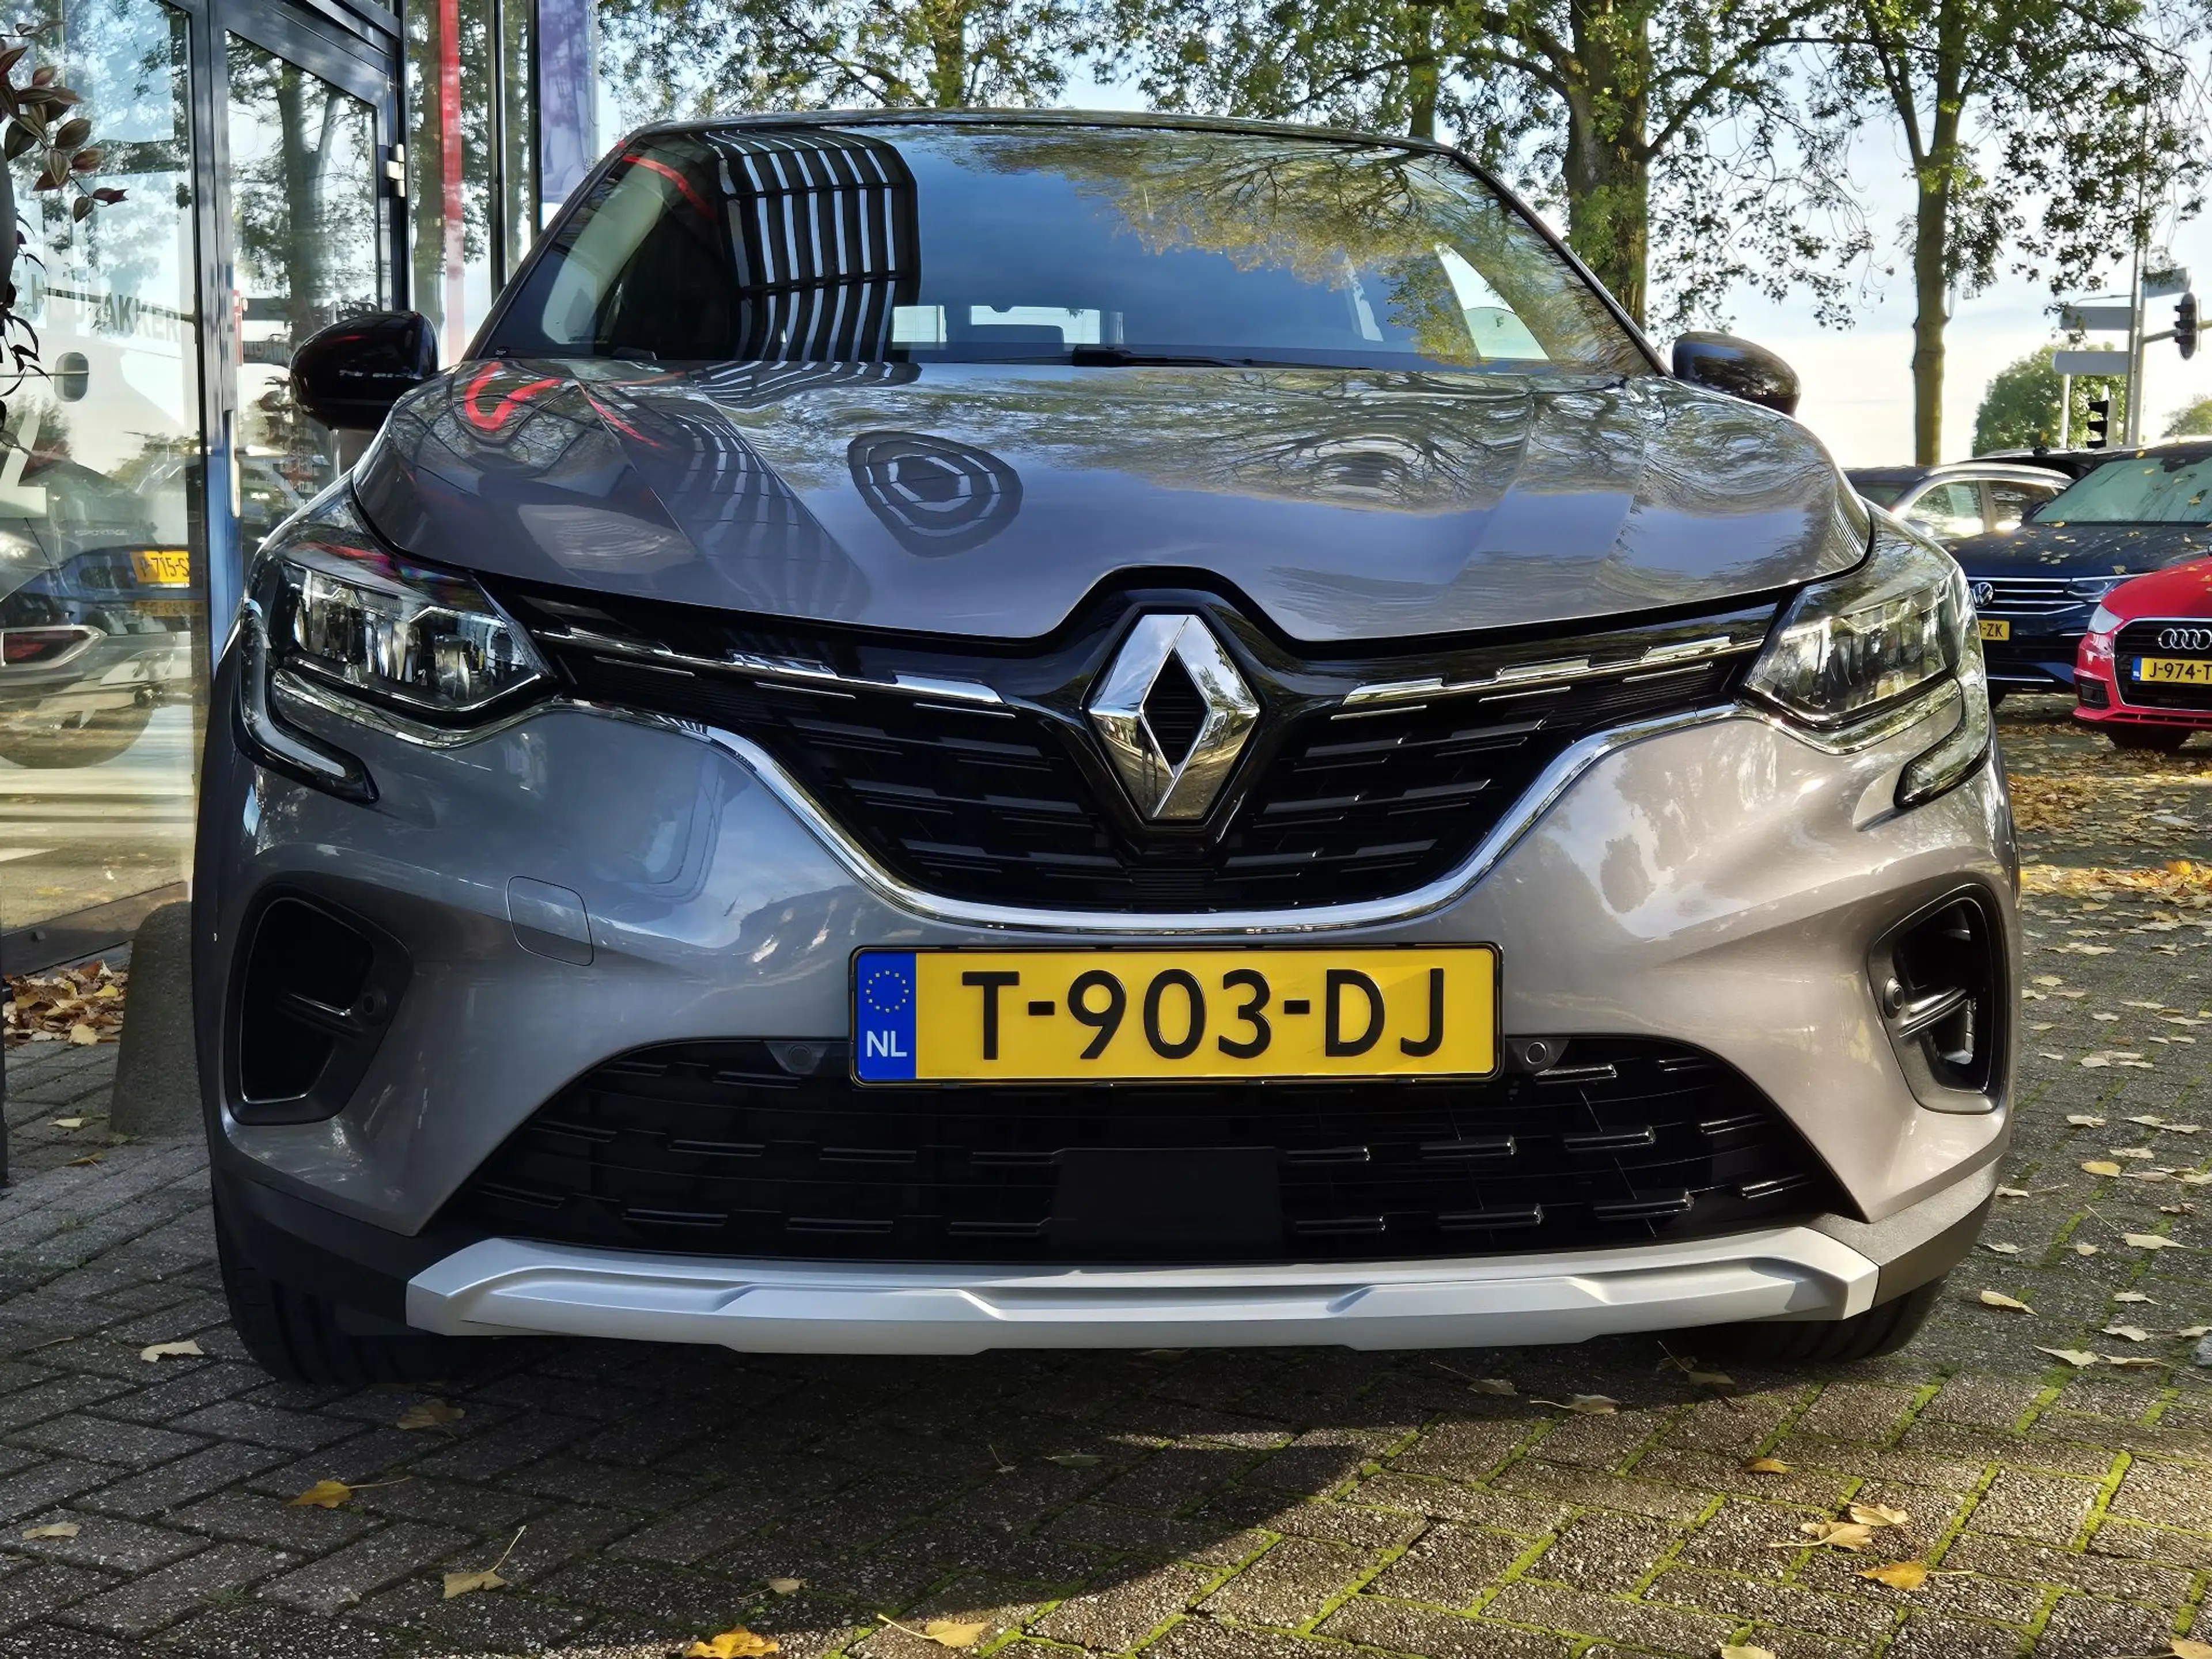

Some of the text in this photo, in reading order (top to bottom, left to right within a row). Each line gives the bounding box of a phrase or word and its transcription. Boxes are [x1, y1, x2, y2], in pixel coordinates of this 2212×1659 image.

[138, 557, 190, 577] P-715-S
[962, 968, 1444, 1060] T-903-DJ
[867, 1031, 907, 1057] NL
